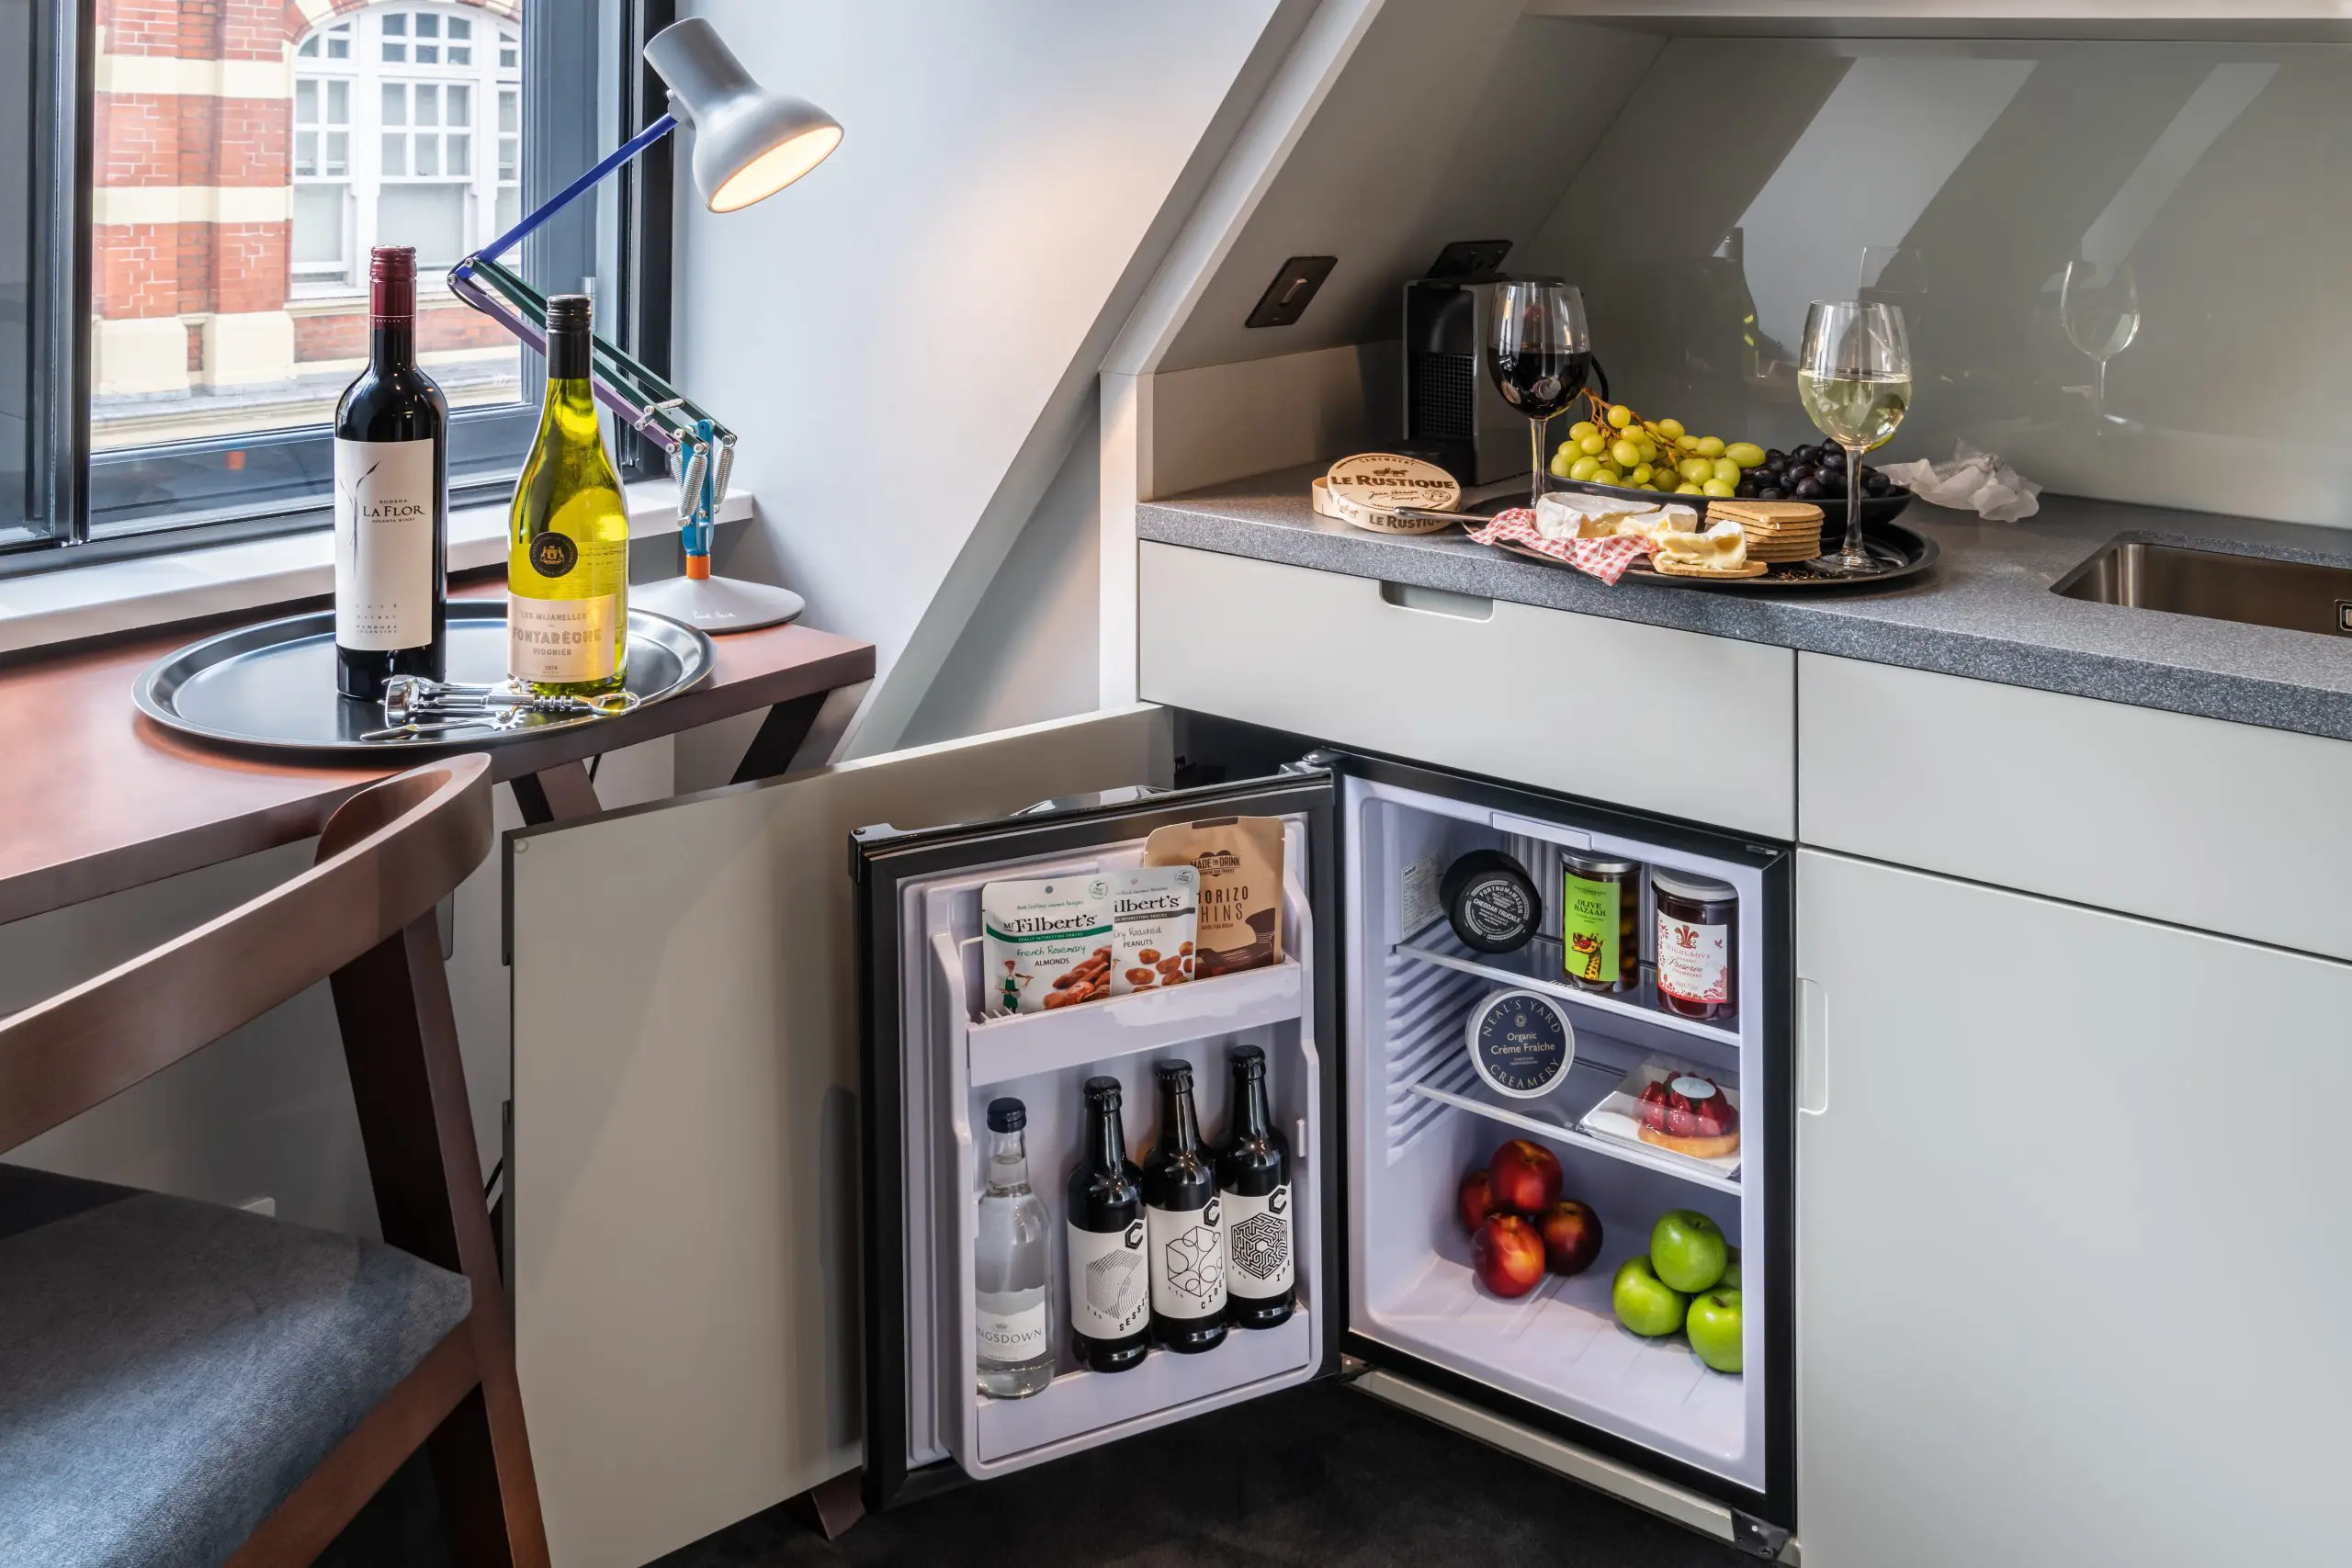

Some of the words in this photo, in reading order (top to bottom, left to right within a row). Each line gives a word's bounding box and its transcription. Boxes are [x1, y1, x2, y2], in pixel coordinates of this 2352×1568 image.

[1359, 457, 1415, 467] CAMEMBERT
[1330, 476, 1353, 486] LE
[1355, 474, 1455, 490] RUSTIQUE
[363, 505, 381, 517] LA
[383, 504, 425, 517] FLOR
[1369, 513, 1385, 526] LE
[533, 648, 571, 656] VIOGNIER
[1190, 858, 1212, 869] MADE
[1219, 856, 1240, 867] DRINK
[1114, 895, 1181, 913] ilbert's
[1473, 897, 1498, 913] CHEDDAR
[1498, 908, 1521, 924] TRUCKLE
[1574, 904, 1606, 917] BAZAAR
[1577, 898, 1602, 910] OLIVE
[1201, 903, 1243, 923] HINS
[1014, 914, 1095, 933] Filbert's
[1128, 926, 1162, 937] Roasted
[1123, 939, 1153, 948] PEANUTS
[1017, 947, 1045, 957] French
[1047, 944, 1086, 955] Rosemary
[1666, 942, 1711, 959] HIGHGROVE
[1035, 957, 1069, 966] ALMONDS
[1668, 958, 1703, 973] Preserve
[1483, 999, 1521, 1037] NEAL'S
[1530, 1001, 1561, 1032] YARD
[1507, 1032, 1537, 1043] Organic
[1490, 1043, 1521, 1055] Crème
[1523, 1042, 1555, 1053] Fraîche
[1490, 1058, 1560, 1089] CREAMERY
